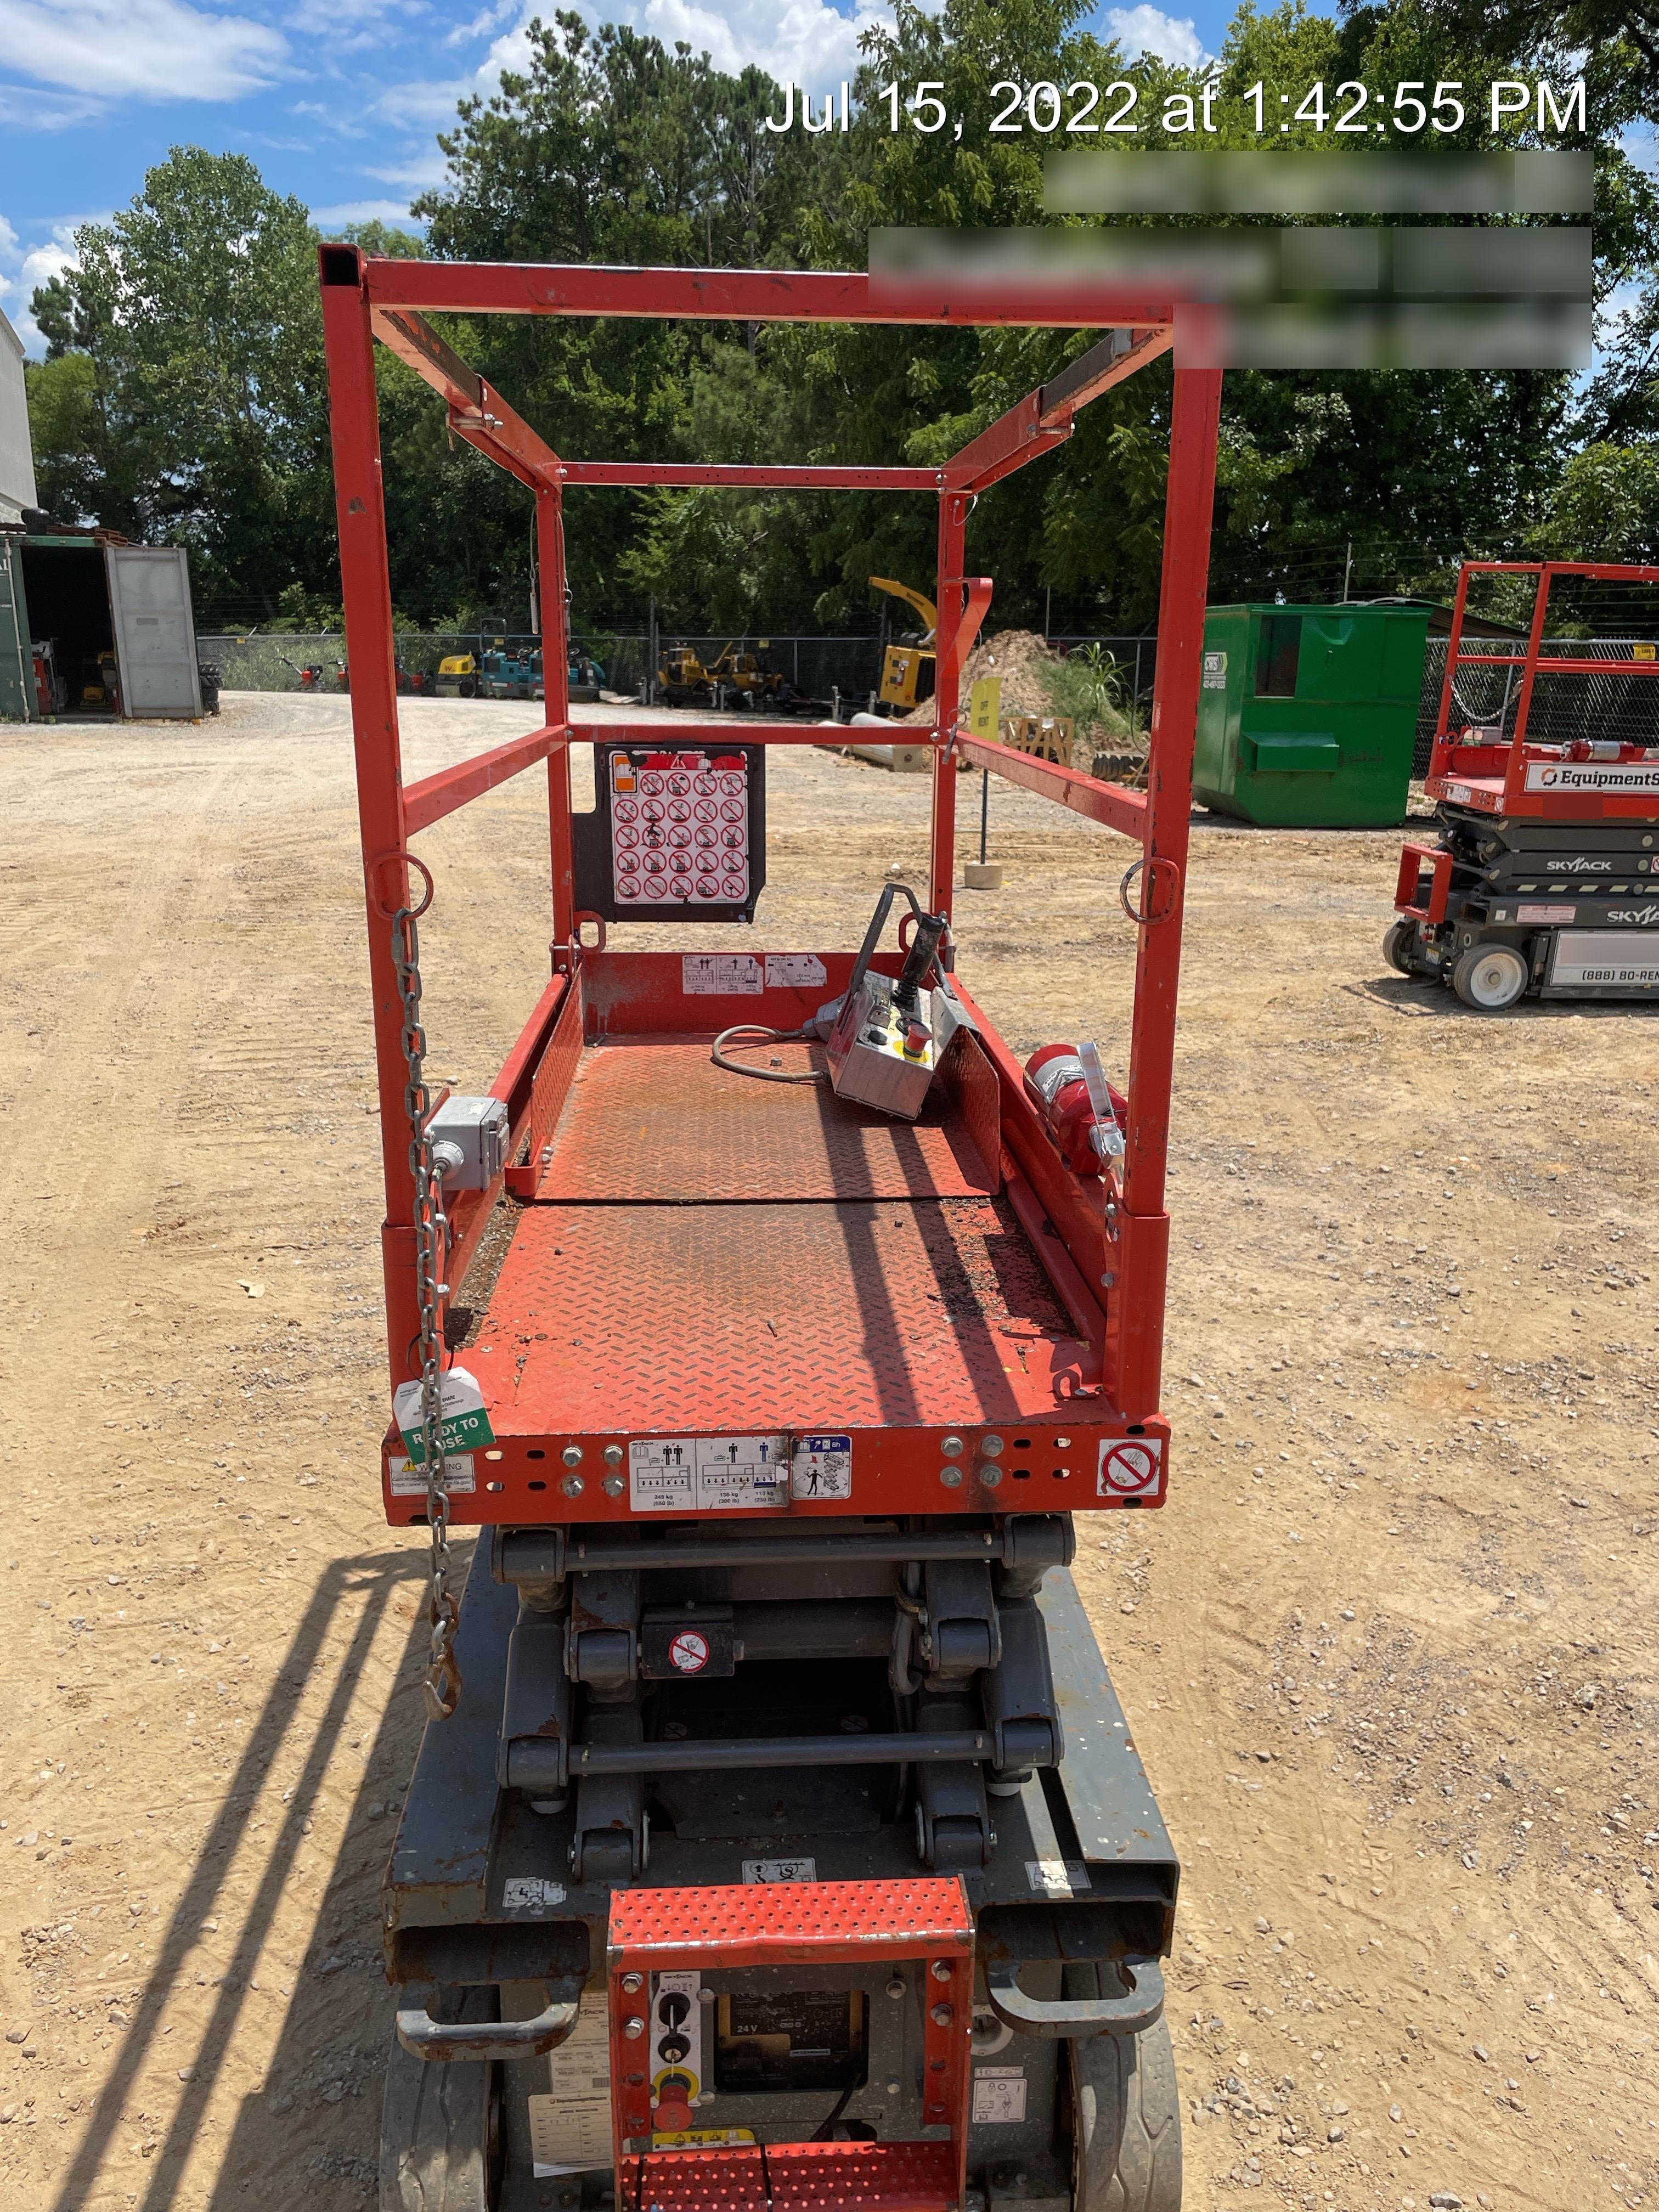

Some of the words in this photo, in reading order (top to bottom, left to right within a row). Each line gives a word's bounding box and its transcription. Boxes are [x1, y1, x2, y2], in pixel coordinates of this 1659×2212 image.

[1547, 856, 1612, 873] SKYJACK
[1582, 970, 1615, 981] (888)
[460, 1417, 479, 1430] TO
